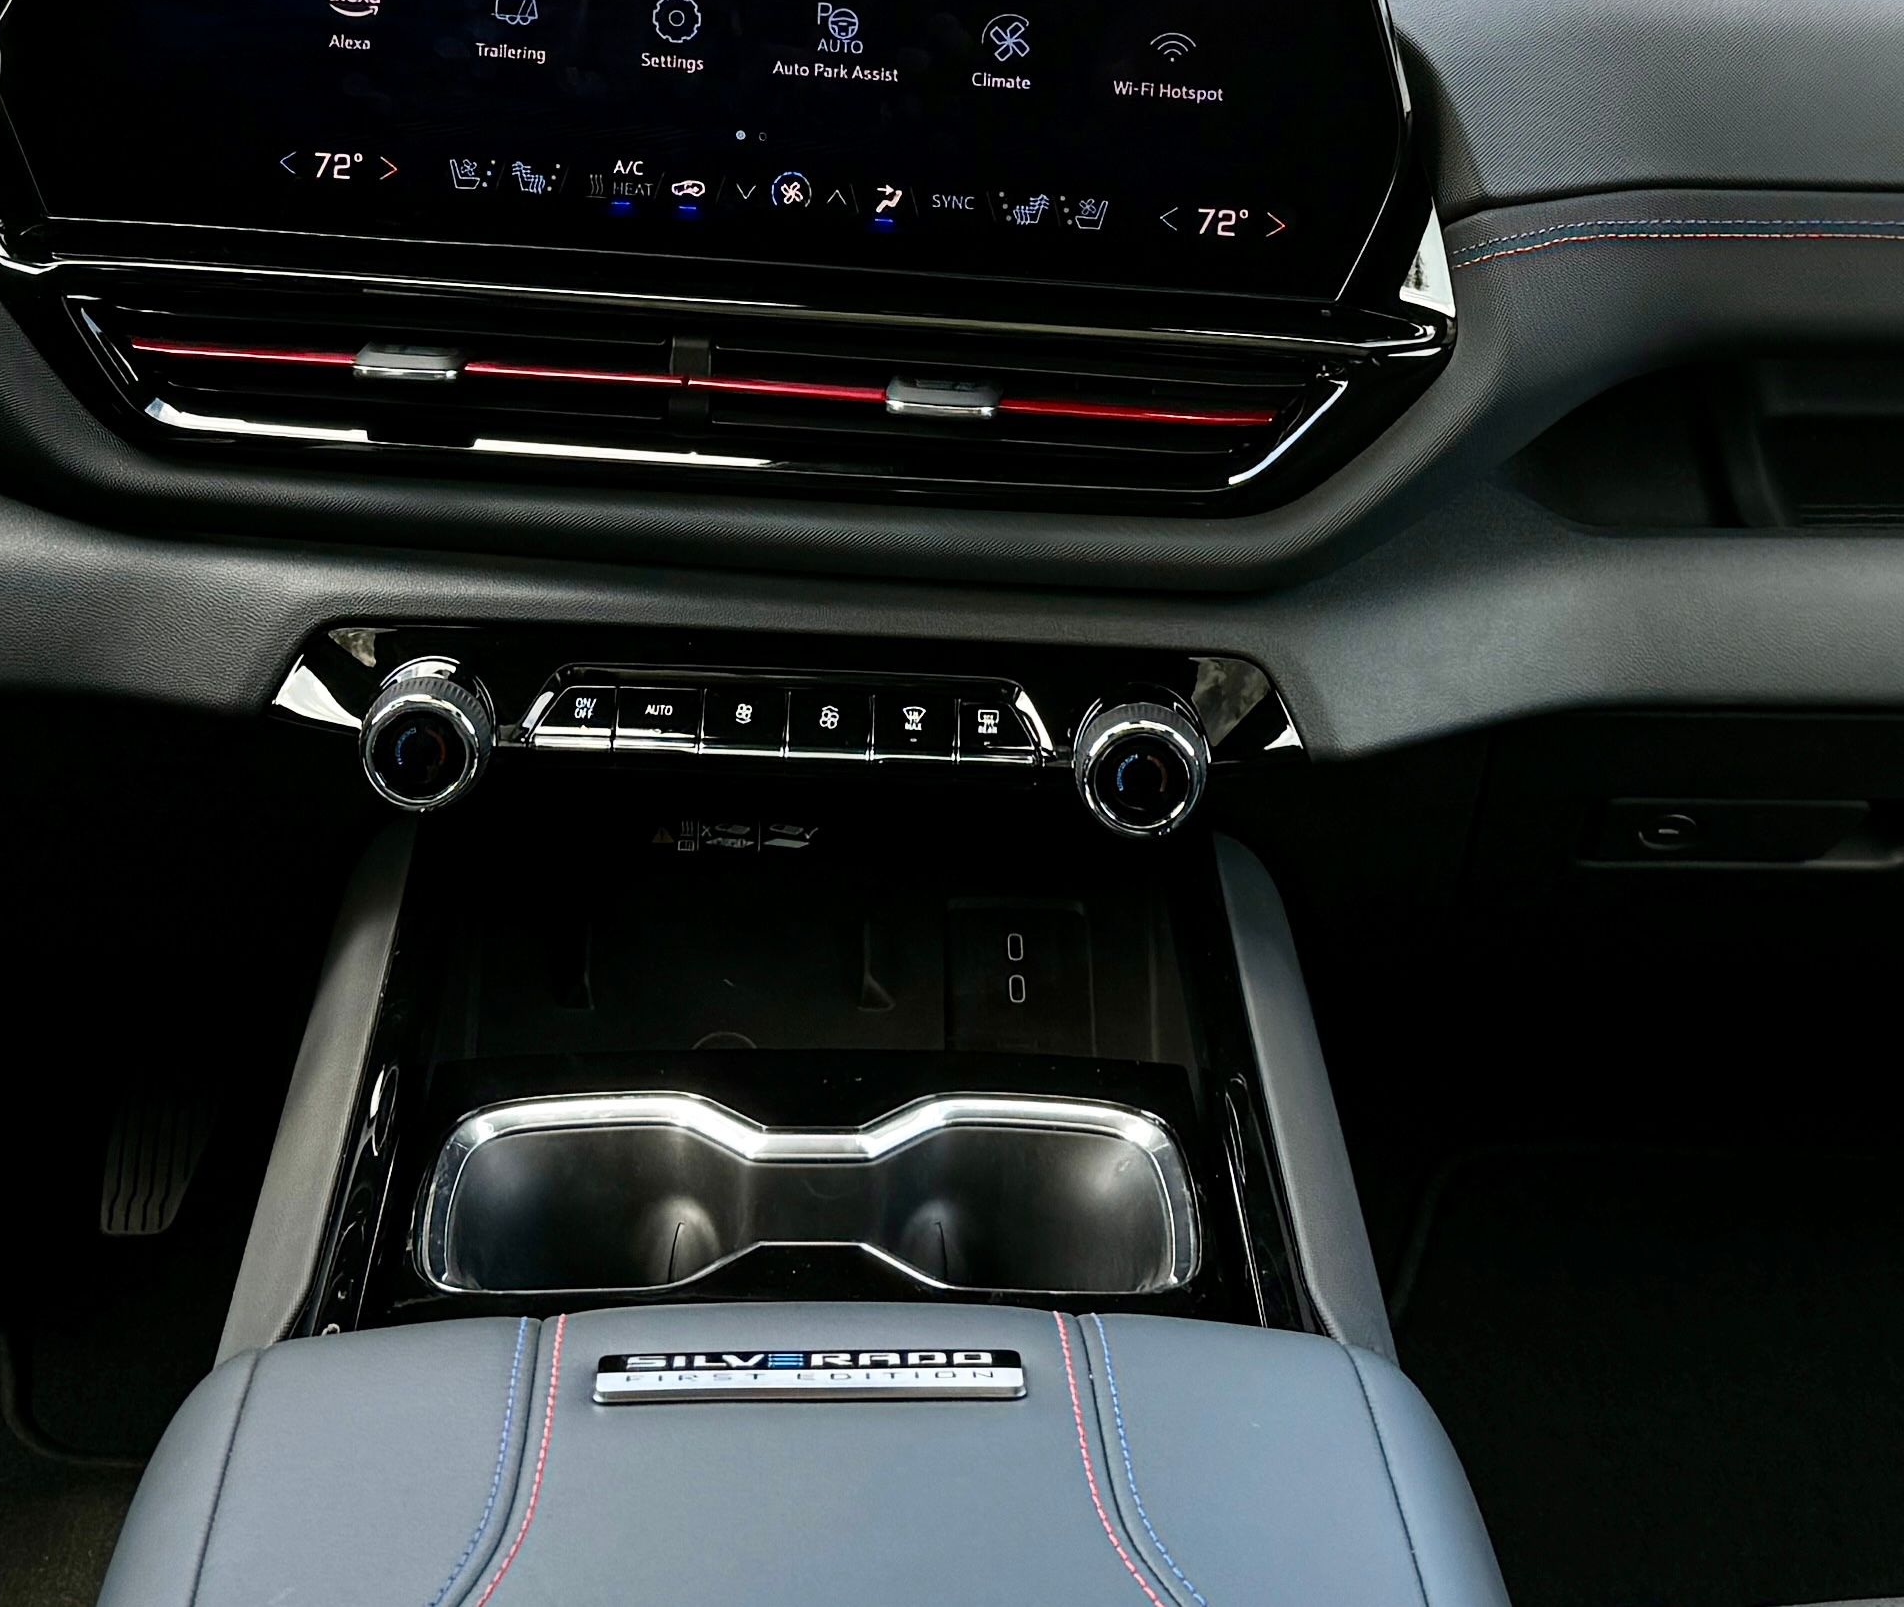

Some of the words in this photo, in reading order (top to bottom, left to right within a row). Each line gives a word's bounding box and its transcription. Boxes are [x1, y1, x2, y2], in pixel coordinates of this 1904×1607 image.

[328, 33, 371, 50] Alexa
[817, 34, 864, 54] AUTO
[475, 42, 546, 65] Trailering
[641, 52, 704, 74] Settings
[772, 60, 810, 77] Auto
[814, 63, 849, 79] Park
[851, 65, 898, 83] Assist
[971, 72, 1031, 90] Climate
[1113, 80, 1155, 97] Wi-Fi
[1159, 83, 1224, 104] Hotspot
[314, 152, 363, 180] 72°
[613, 159, 644, 176] A/C
[613, 182, 653, 196] HEAT
[932, 193, 975, 210] SYNC
[1197, 208, 1249, 237] 72°
[576, 698, 596, 709] ON/
[645, 704, 673, 716] AUTO
[575, 708, 594, 719] OFF
[627, 1352, 993, 1368] SILVERADO
[625, 1372, 768, 1382] FIRST
[796, 1370, 995, 1381] EDITION
